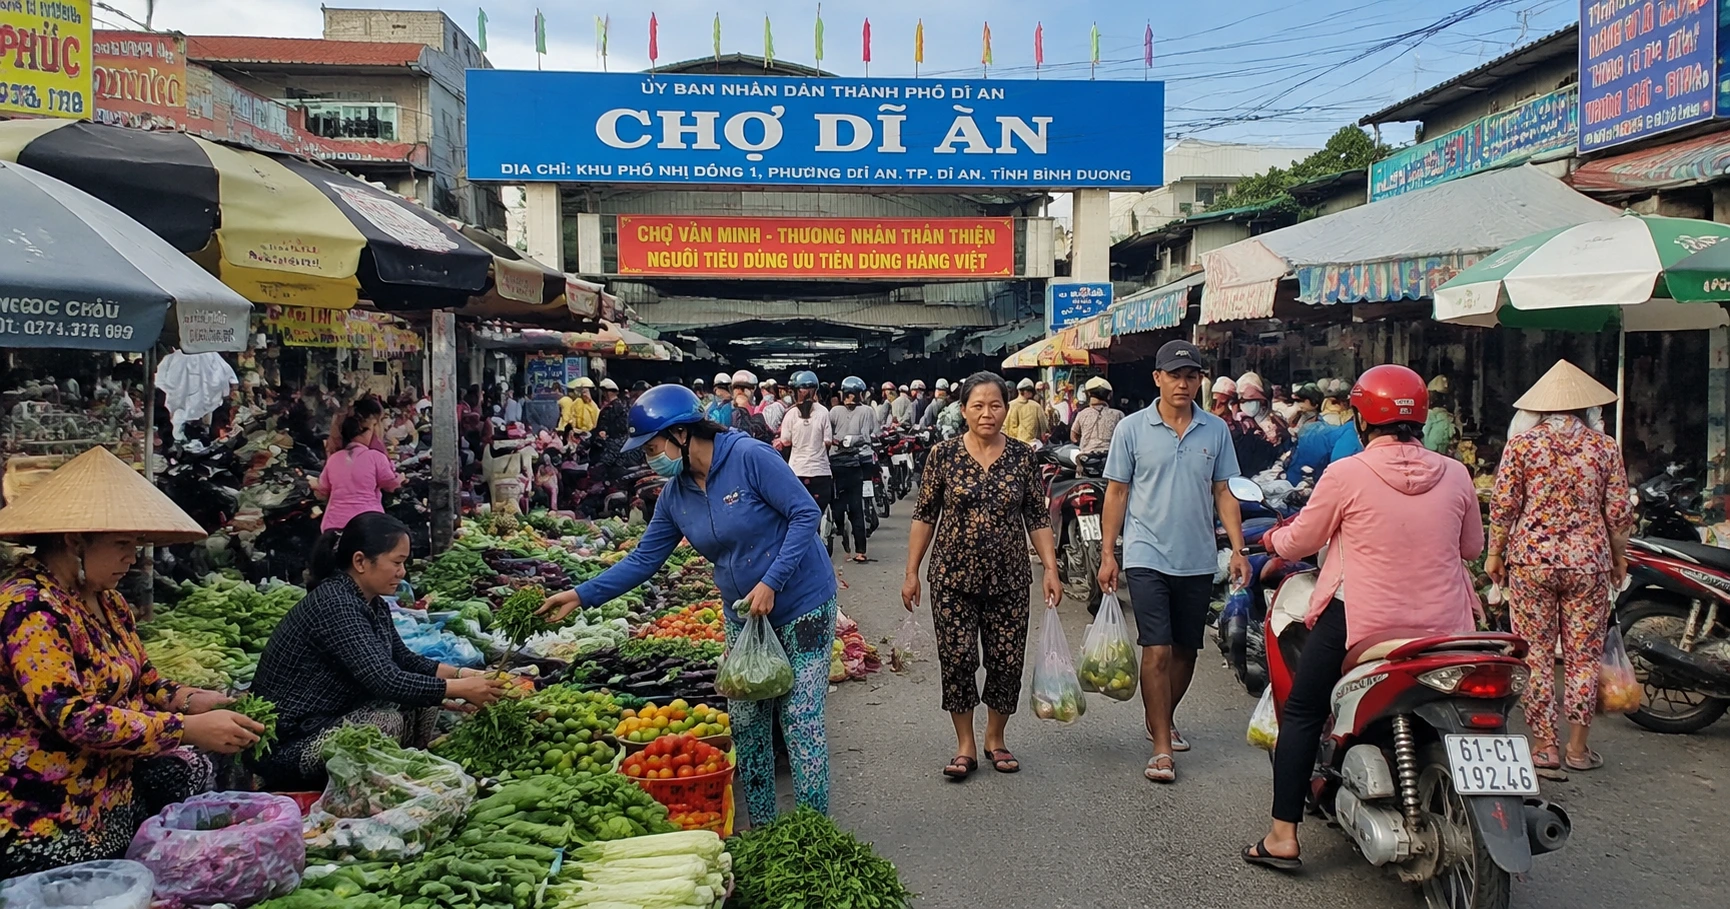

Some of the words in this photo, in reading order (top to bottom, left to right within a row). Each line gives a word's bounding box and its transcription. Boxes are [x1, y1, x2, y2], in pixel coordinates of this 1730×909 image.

[675, 84, 714, 94] BAN
[978, 88, 1003, 99] AN
[596, 106, 786, 161] CHỢ
[813, 102, 906, 153] DĨ
[577, 165, 611, 175] KHU
[750, 167, 762, 178] 1,
[906, 169, 932, 178] TP.
[958, 170, 985, 179] AN.
[718, 227, 760, 243] MINH
[949, 225, 995, 248] THIỆN
[1459, 737, 1519, 762] 61-C1
[1459, 766, 1532, 790] 192.46
